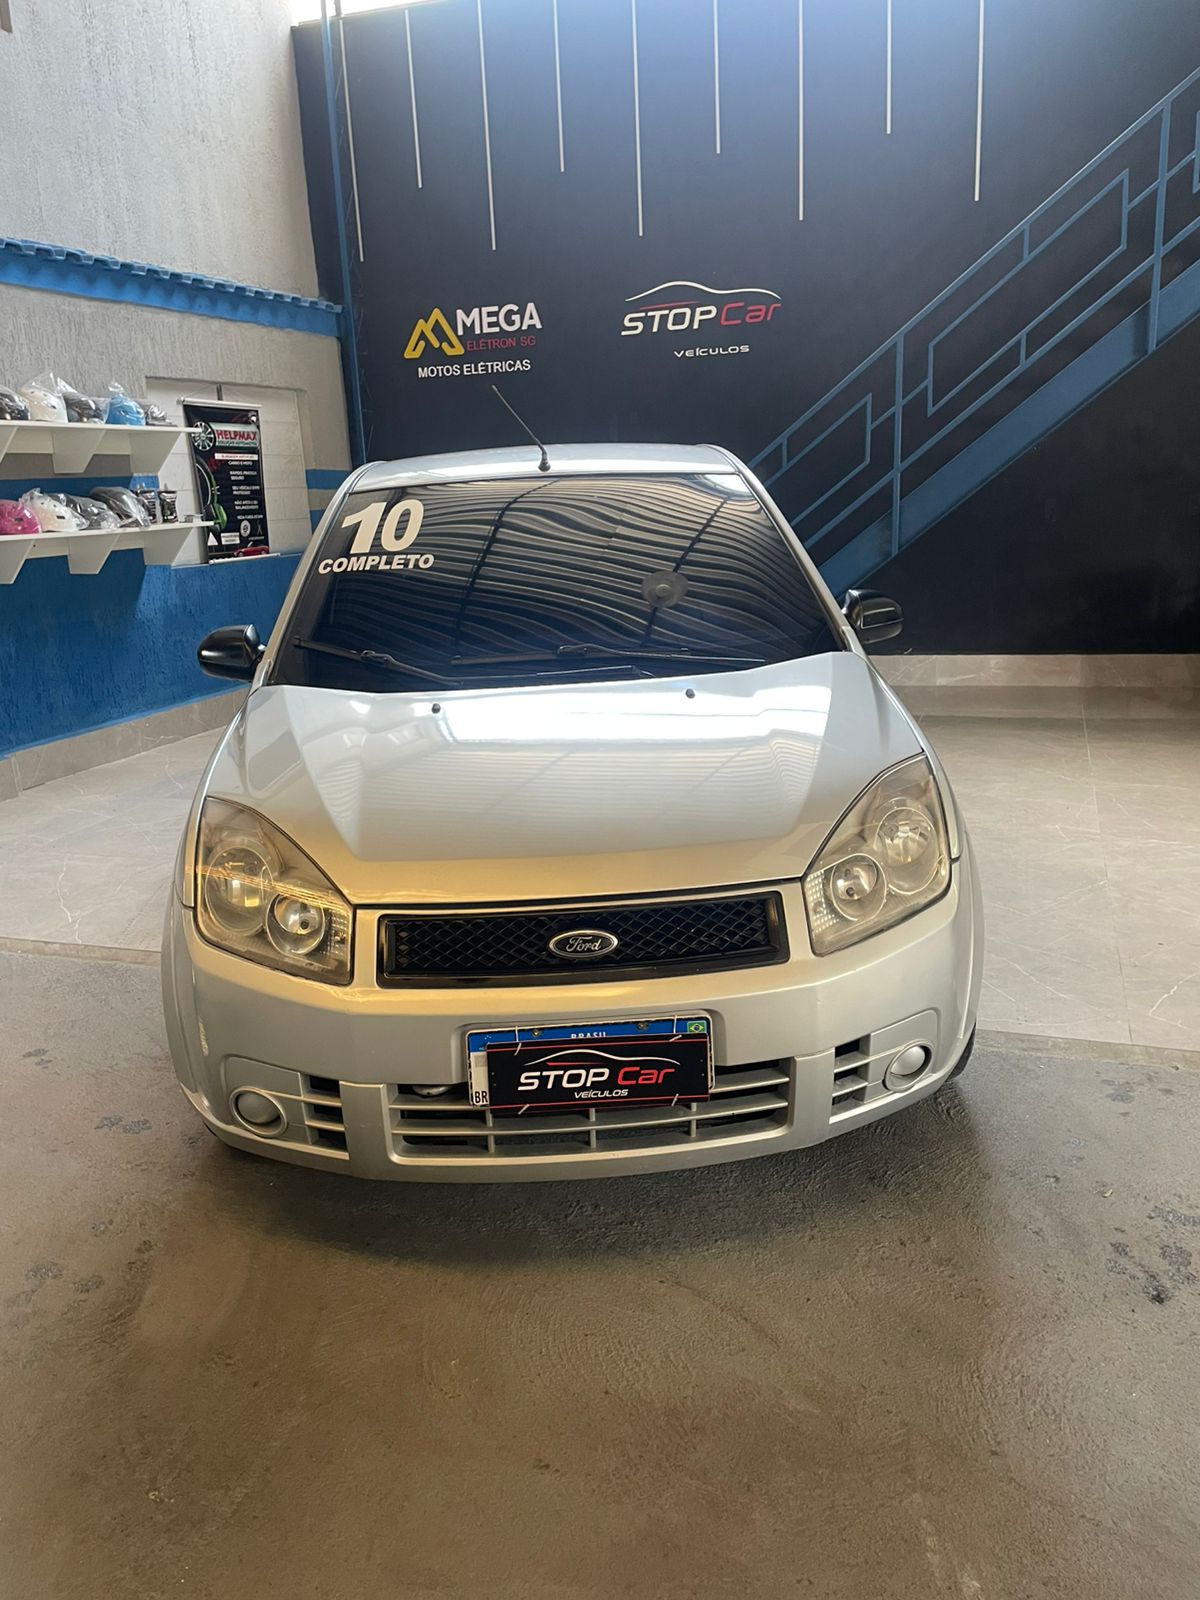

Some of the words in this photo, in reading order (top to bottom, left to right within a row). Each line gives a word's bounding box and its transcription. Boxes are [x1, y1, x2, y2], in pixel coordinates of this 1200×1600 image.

[456, 302, 542, 335] MEGA
[621, 305, 717, 336] STOP
[720, 302, 782, 326] Car
[520, 335, 537, 347] SG
[418, 364, 461, 379] MOTOS
[463, 359, 531, 376] ELÉTRICAS
[215, 429, 257, 441] HELPMAX
[341, 499, 424, 554] 10
[318, 553, 435, 574] COMPLETO
[565, 936, 602, 952] Ford
[517, 1068, 610, 1091] STOP
[617, 1066, 675, 1085] Car
[474, 1090, 488, 1104] BR
[574, 1089, 629, 1099] VEÍCULOS
